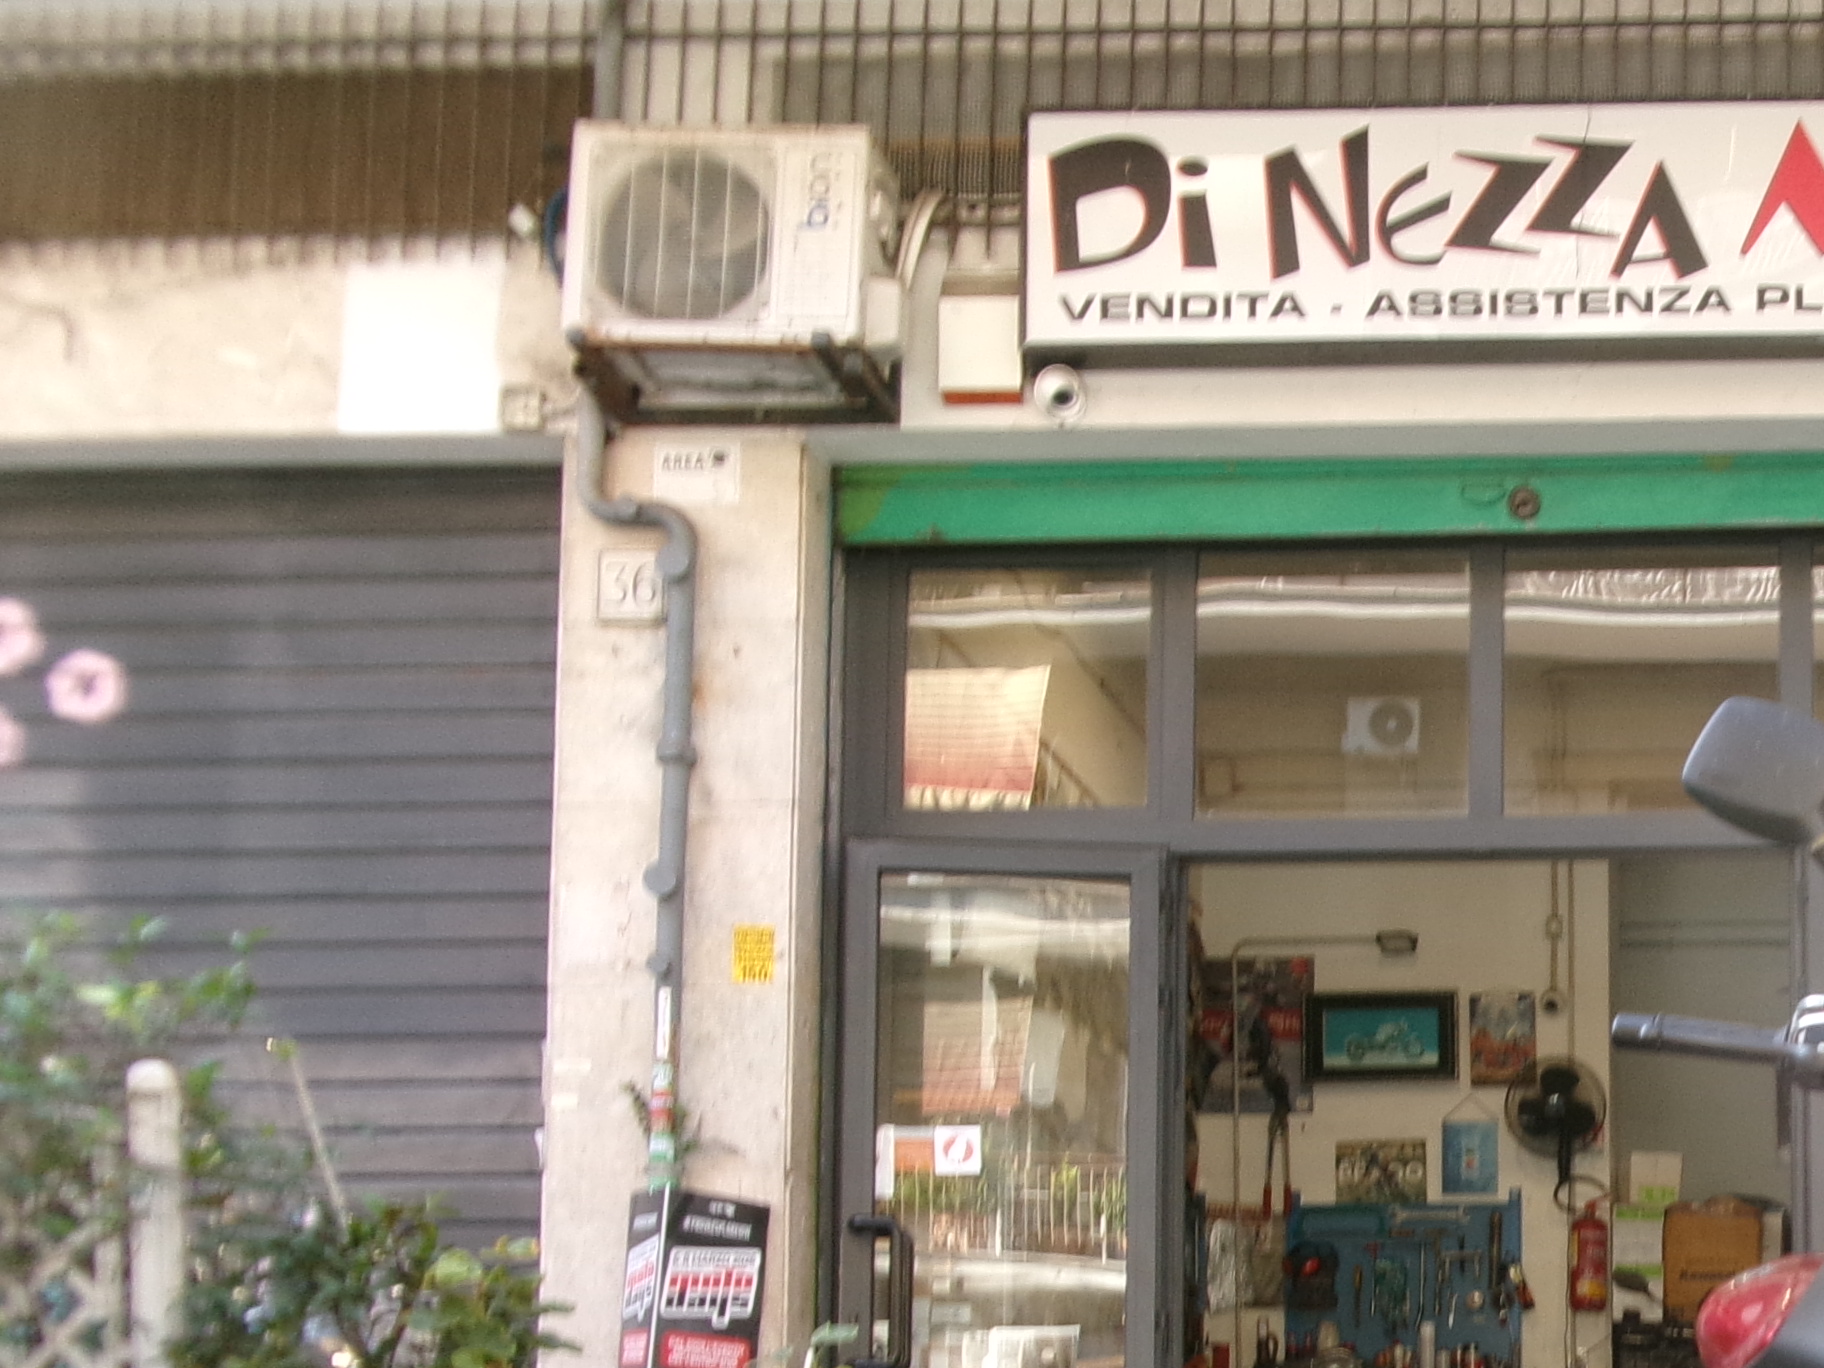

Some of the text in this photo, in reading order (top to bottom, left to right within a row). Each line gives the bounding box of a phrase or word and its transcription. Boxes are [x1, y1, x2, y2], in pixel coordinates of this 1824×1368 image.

[1047, 134, 1217, 279] Di
[1060, 291, 1308, 324] VENDITA
[1365, 284, 1733, 322] ASSISTENZA
[604, 559, 657, 606] 36
